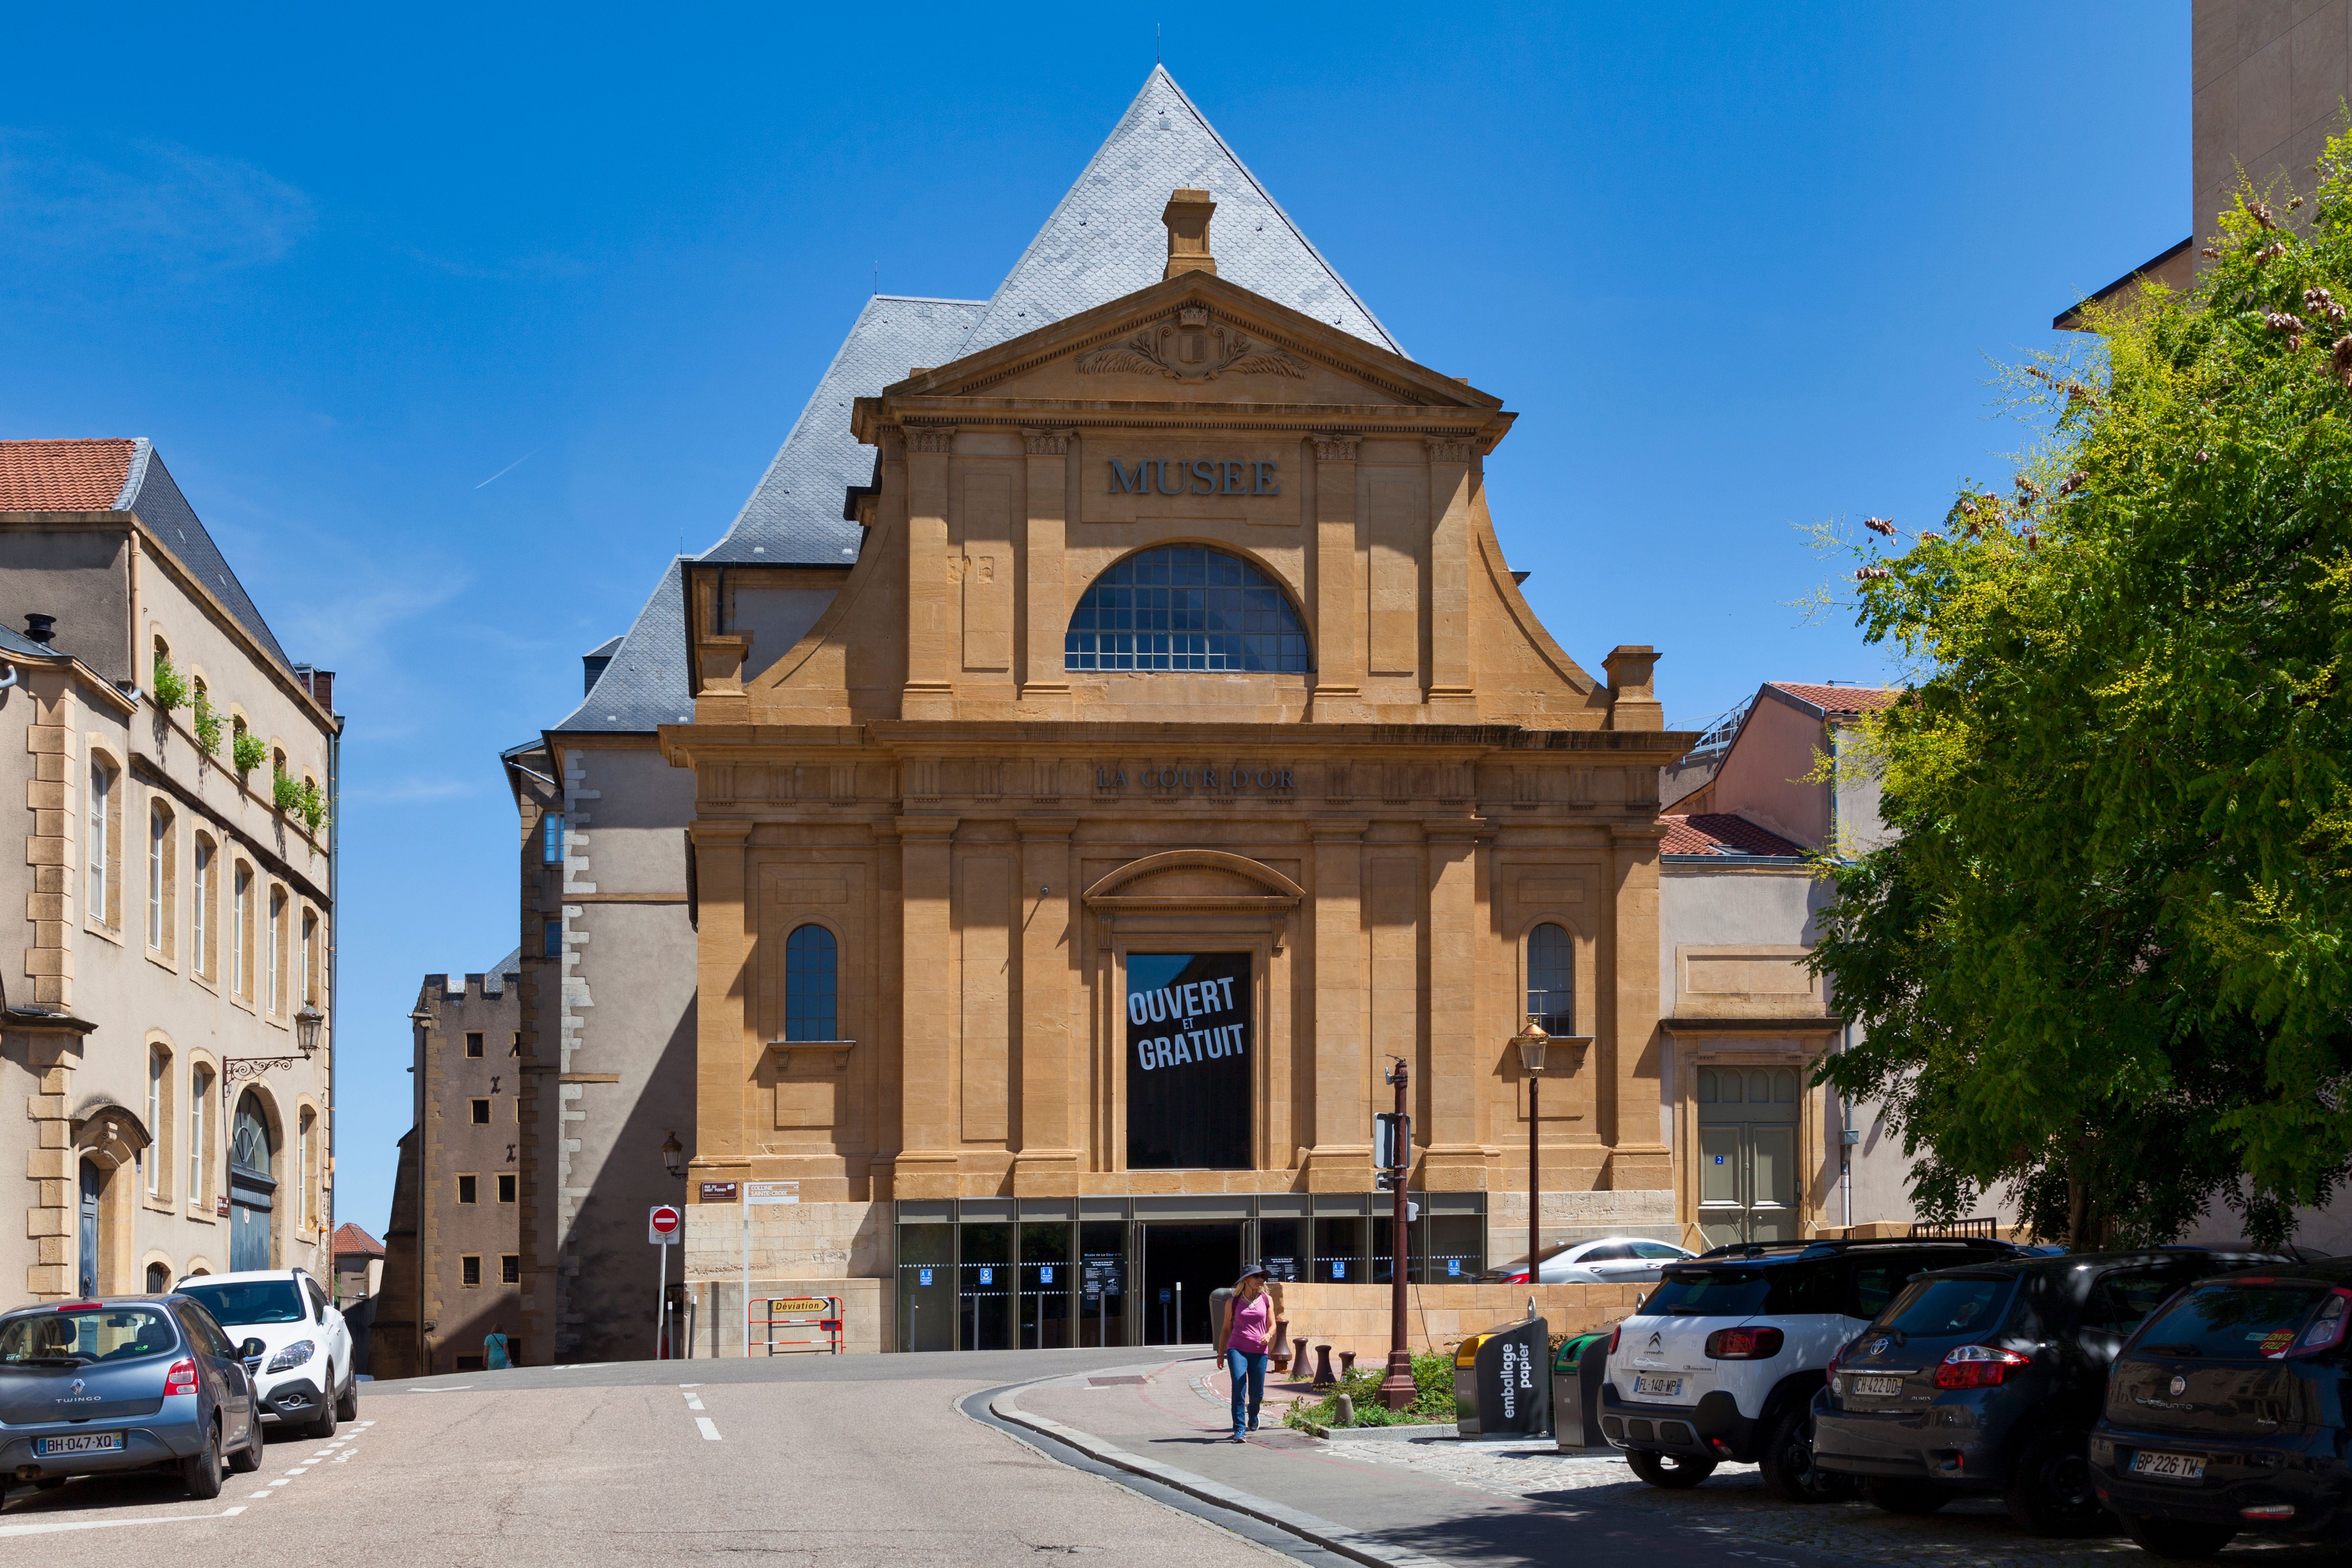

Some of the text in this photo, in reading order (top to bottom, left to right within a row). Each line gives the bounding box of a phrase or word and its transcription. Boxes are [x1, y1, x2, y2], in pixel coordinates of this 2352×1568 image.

[1108, 459, 1280, 495] MUSEE
[1097, 769, 1295, 788] LA COUR D'OR
[1129, 976, 1234, 1025] OUVERT
[1182, 1018, 1194, 1030] ET
[1138, 1023, 1244, 1070] GRATUIT
[776, 1302, 819, 1310] Déviation
[1500, 1344, 1517, 1418] emballage
[1517, 1343, 1532, 1388] papier
